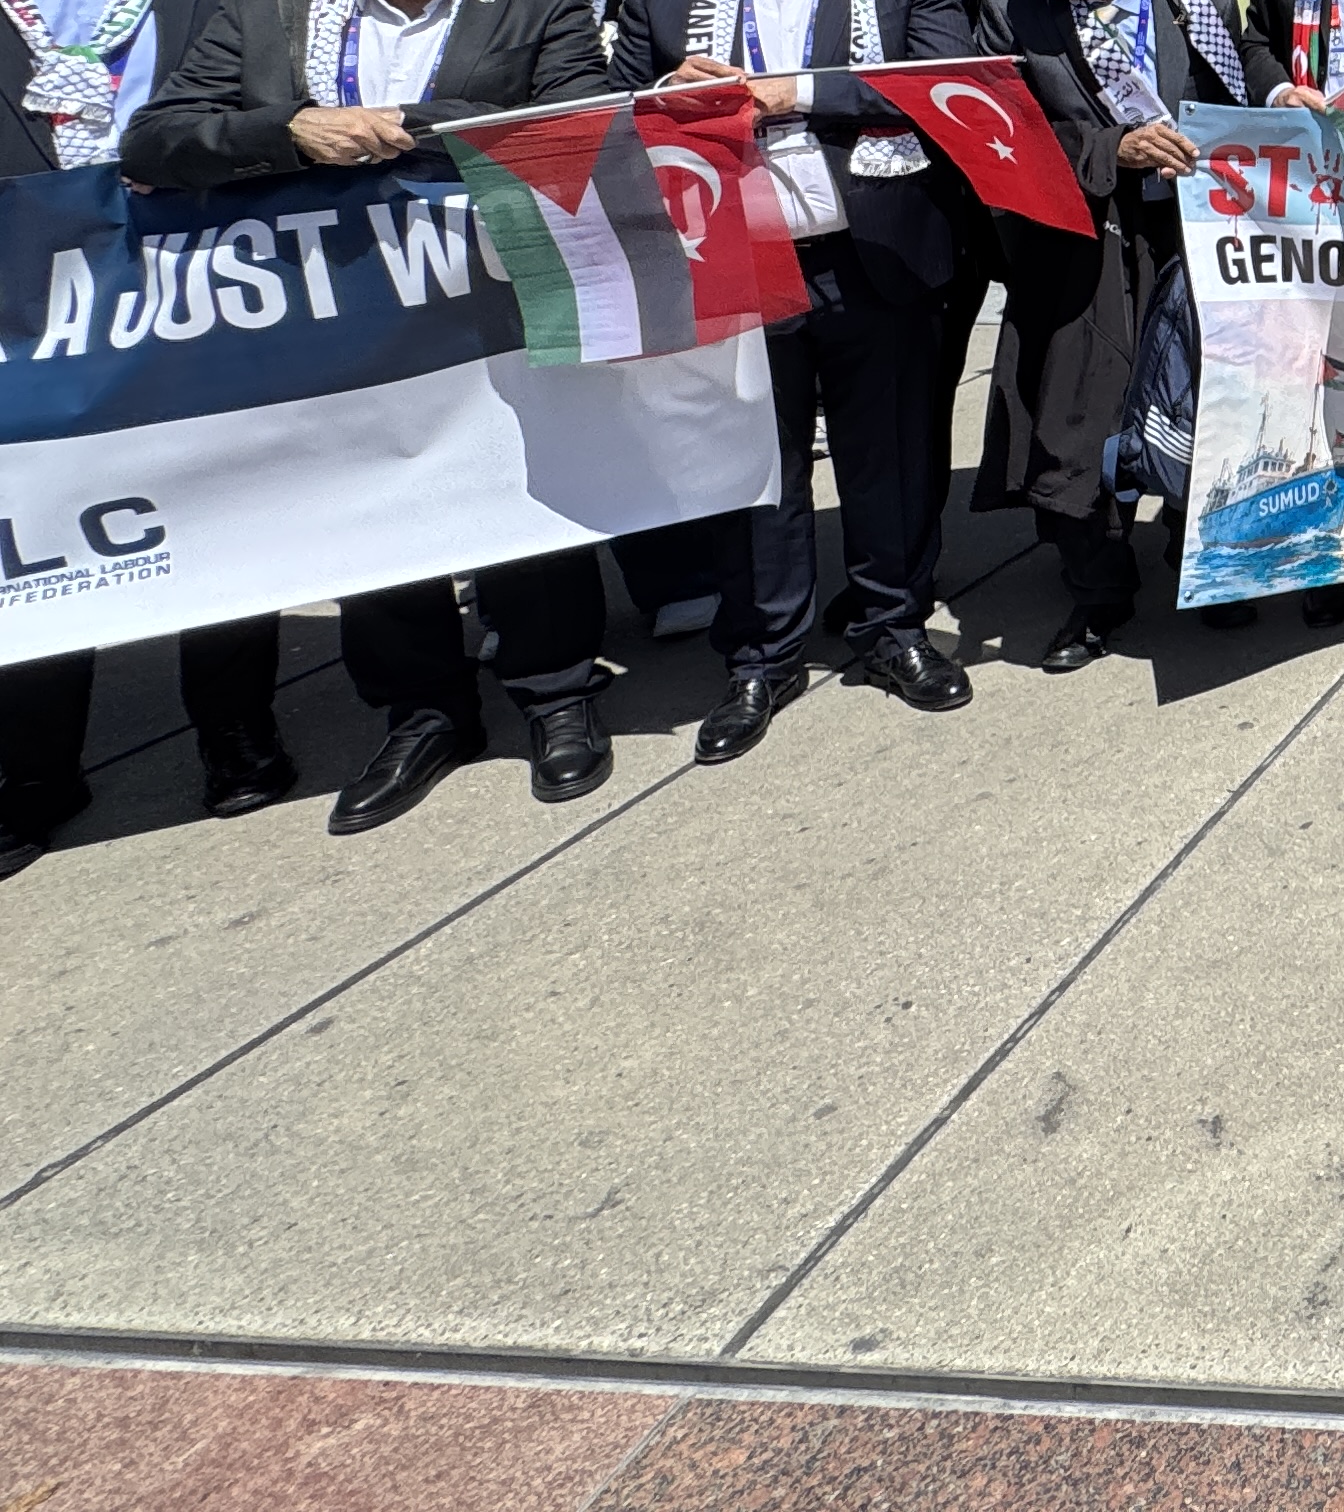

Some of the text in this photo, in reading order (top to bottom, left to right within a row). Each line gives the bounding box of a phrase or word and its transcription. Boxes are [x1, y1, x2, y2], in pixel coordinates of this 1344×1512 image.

[32, 248, 95, 360] A
[110, 210, 338, 348] JUST
[1259, 482, 1320, 517] SUMUD
[0, 496, 166, 581] LC
[100, 551, 171, 575] LABOUR
